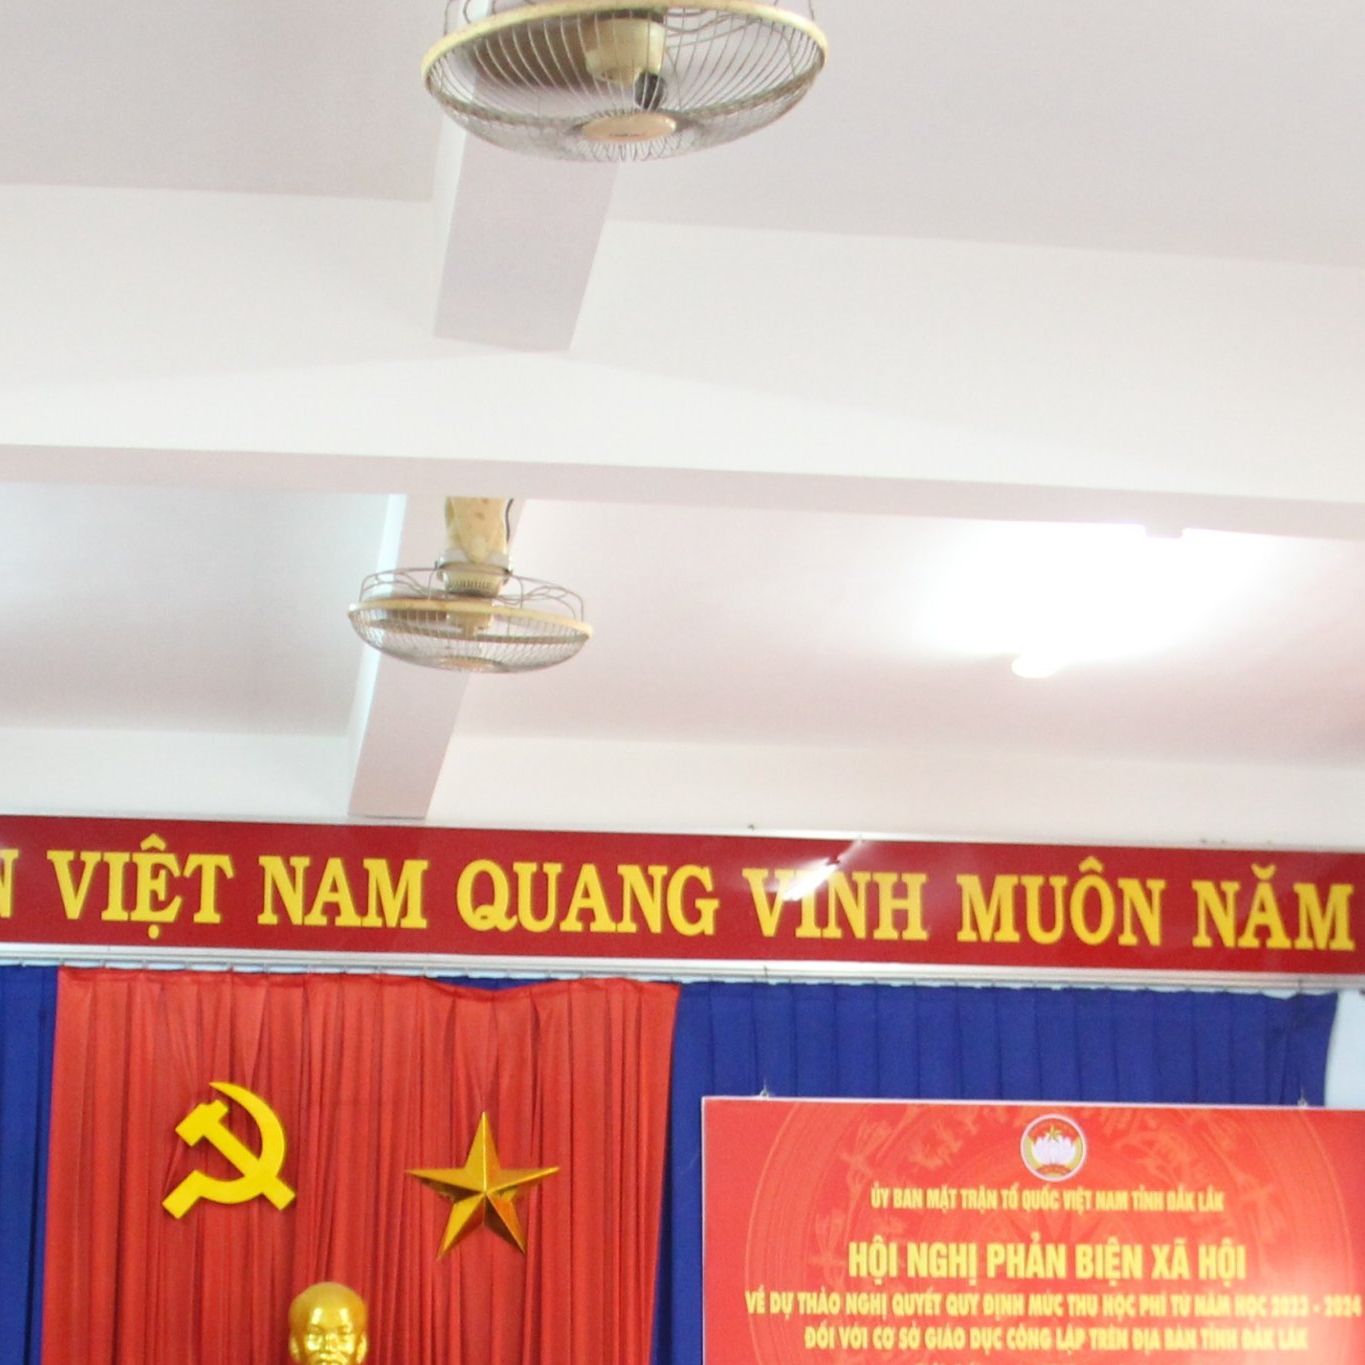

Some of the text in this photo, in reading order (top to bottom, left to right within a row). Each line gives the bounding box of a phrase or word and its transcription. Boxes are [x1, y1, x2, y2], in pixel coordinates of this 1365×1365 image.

[47, 832, 235, 940] VIỆT
[258, 855, 429, 929] NAM
[456, 858, 720, 937] QUANG
[742, 867, 928, 941] VINH
[957, 855, 1165, 949] MUÔN
[1192, 863, 1354, 952] NĂM
[871, 1181, 1224, 1216] ỦY BAN MẶT TRẬN TỔ QUỐC VIỆT NAM TỈNH ĐẮK LẮK
[848, 1231, 1246, 1287] HỘI NGHỊ PHẢN BIỆN XÃ HỘI
[745, 1284, 765, 1314] VỀ
[769, 1291, 794, 1320] DỰ
[797, 1286, 841, 1315] THẢO
[845, 1292, 887, 1320] NGHỊ
[892, 1286, 942, 1316] QUYẾT
[946, 1292, 980, 1317] QUY
[983, 1293, 1024, 1321] ĐỊNH
[1028, 1289, 1064, 1317] MỨC
[1067, 1294, 1098, 1317] THU
[1102, 1294, 1135, 1322] HỌC
[1139, 1290, 1166, 1317] PHÍ
[1170, 1291, 1191, 1317] TỪ
[1194, 1289, 1231, 1317] NĂM
[1235, 1293, 1267, 1321] HỌC
[1271, 1294, 1309, 1318] 2023
[1323, 1294, 1363, 1318] 2024
[804, 1320, 1310, 1355] ĐỐI VỚI CƠ SỞ GIÁO DỤC CÔNG LẬP TRÊN ĐỊA BÀN TỈNH ĐẮK LẮK
